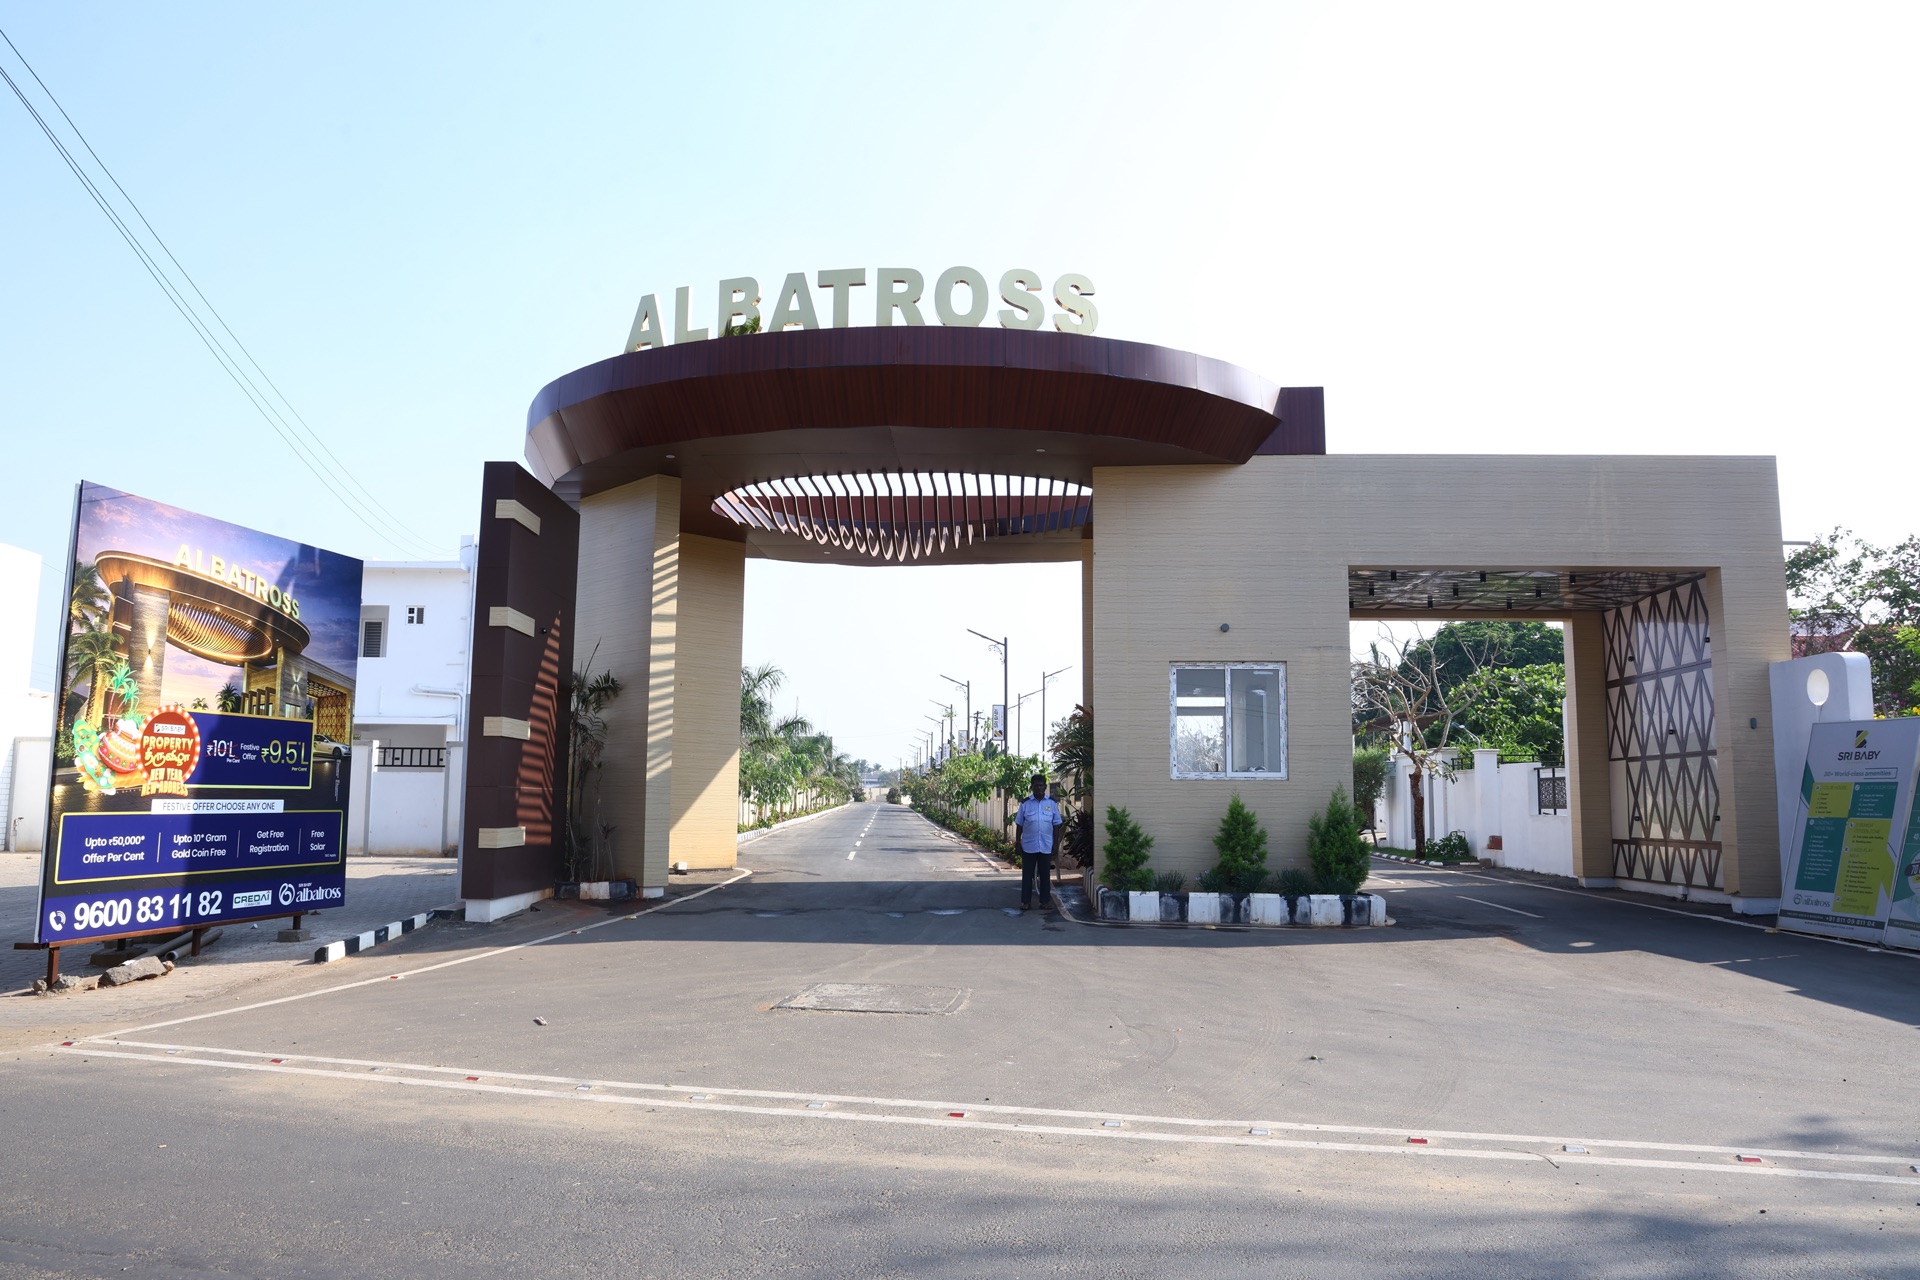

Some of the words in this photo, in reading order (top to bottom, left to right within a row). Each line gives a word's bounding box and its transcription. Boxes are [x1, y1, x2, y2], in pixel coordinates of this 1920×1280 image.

[622, 265, 1098, 355] ALBATROSS
[173, 543, 300, 620] ALBATROSS
[143, 735, 194, 751] PROPERTY
[240, 742, 260, 751] Festive
[144, 746, 190, 767] திருவிழா
[242, 752, 257, 761] Offer
[1837, 751, 1853, 761] SRI
[1853, 750, 1881, 761] BABY
[150, 768, 166, 781] NEW
[166, 768, 183, 781] YEAR
[140, 782, 158, 797] NEW
[157, 780, 189, 797] ADDRESS
[162, 802, 191, 811] FESTIVE
[192, 802, 214, 811] OFFER
[215, 802, 245, 811] CHOOSE
[246, 802, 261, 811] ANY
[261, 802, 275, 810] ONE
[173, 834, 193, 846] Upto
[205, 833, 227, 842] Gram
[256, 830, 269, 839] Get
[269, 830, 285, 839] Free
[311, 830, 325, 838] Free
[85, 837, 107, 850] Upto
[249, 843, 290, 855] Registration
[310, 843, 326, 851] Solar
[82, 853, 106, 864] Offer
[107, 852, 122, 863] Per
[123, 851, 145, 862] Cent
[171, 849, 191, 859] Gold
[191, 848, 210, 858] Coin
[210, 847, 227, 857] Free
[234, 892, 270, 904] CREDAI
[295, 886, 342, 903] albatross
[1802, 897, 1831, 908] albatross
[73, 898, 133, 931] 9600
[136, 895, 164, 923] 83
[169, 892, 192, 919] 11
[198, 890, 223, 916] 82
